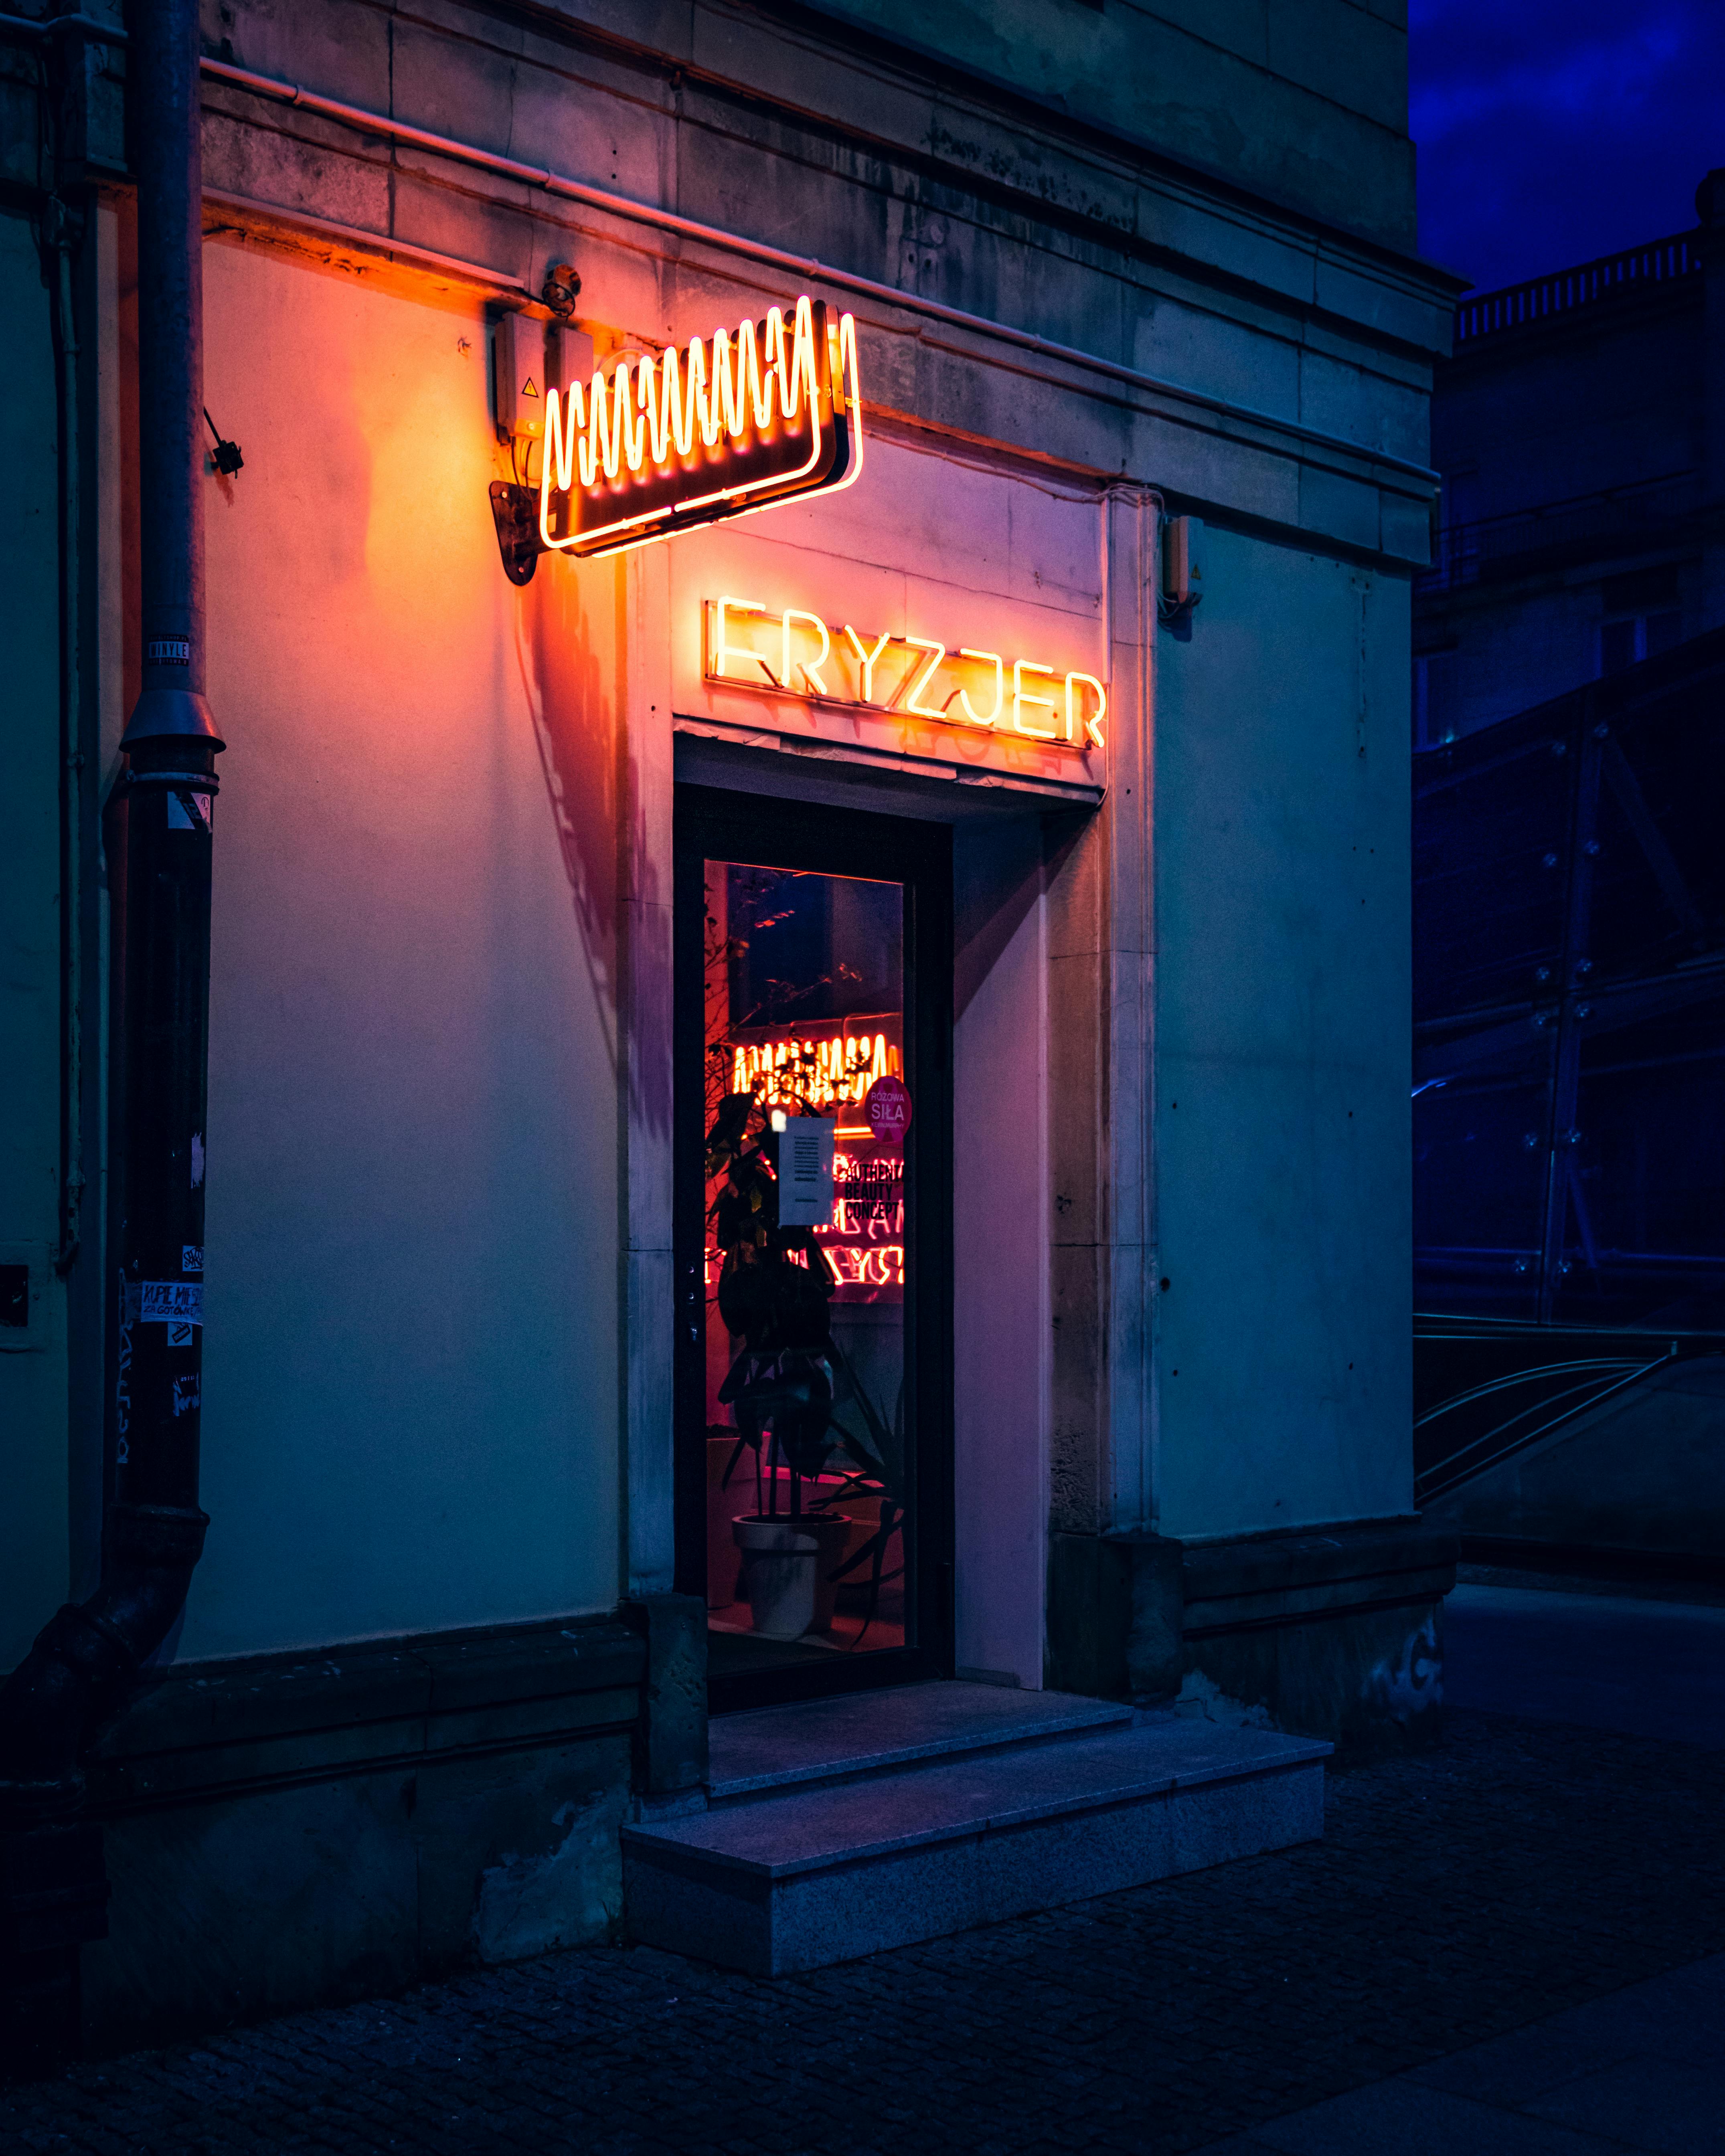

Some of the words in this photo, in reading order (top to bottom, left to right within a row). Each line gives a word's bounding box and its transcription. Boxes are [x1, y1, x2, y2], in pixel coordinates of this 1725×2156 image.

[151, 643, 186, 657] WINYLE
[715, 595, 1106, 748] FRYZJER
[871, 1090, 905, 1102] RÓŻOWA
[871, 1103, 904, 1121] SIŁA
[846, 1163, 905, 1182] AUTHENTI
[845, 1183, 893, 1201] BEAUTY
[845, 1201, 899, 1220] CONCEPT
